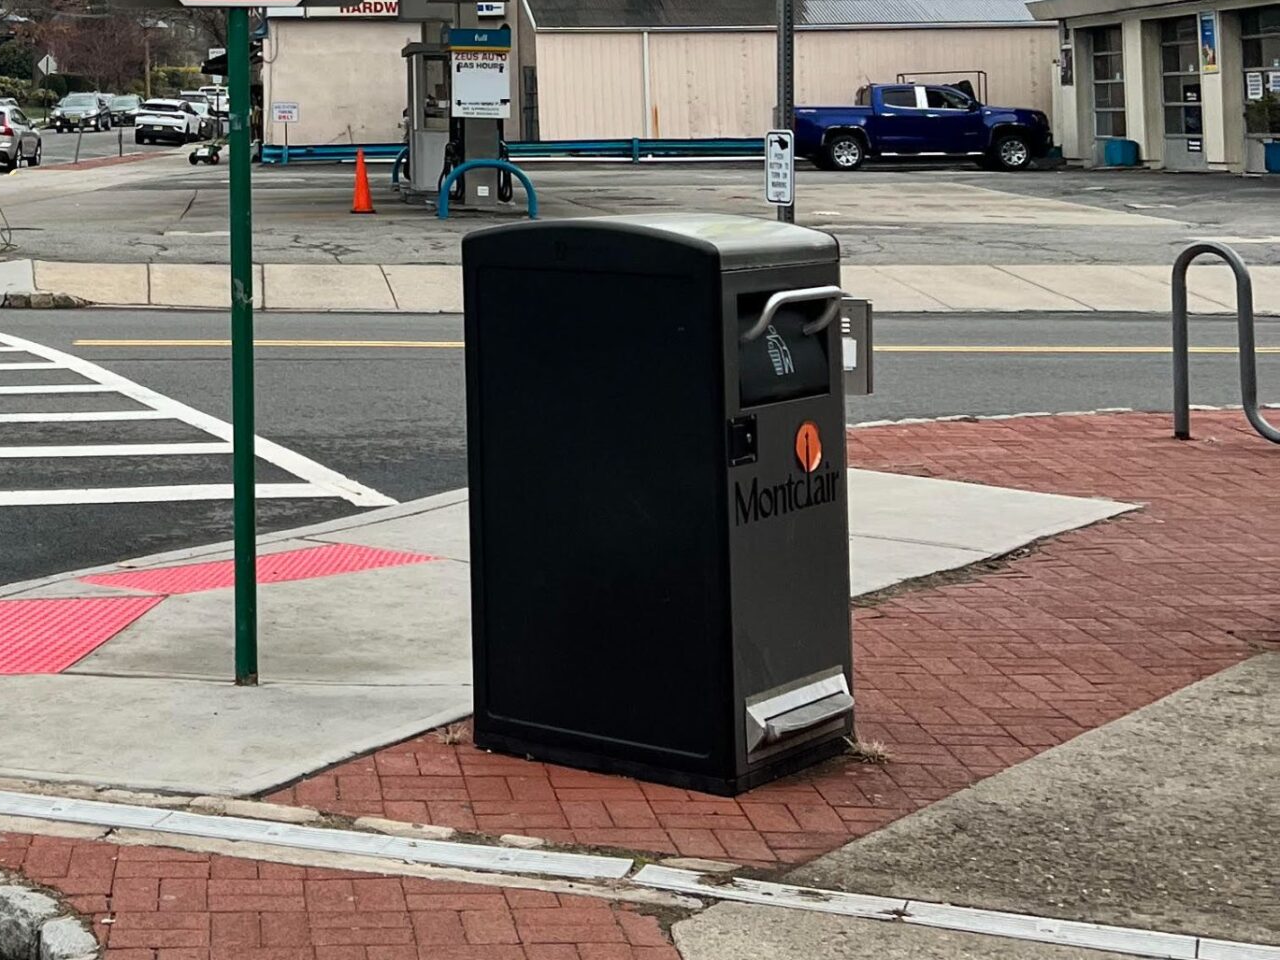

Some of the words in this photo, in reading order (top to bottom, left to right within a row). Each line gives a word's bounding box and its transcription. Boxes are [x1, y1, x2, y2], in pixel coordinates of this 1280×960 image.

[455, 53, 479, 61] ZEUS
[482, 53, 507, 62] AUTO
[734, 461, 840, 527] Montclair
